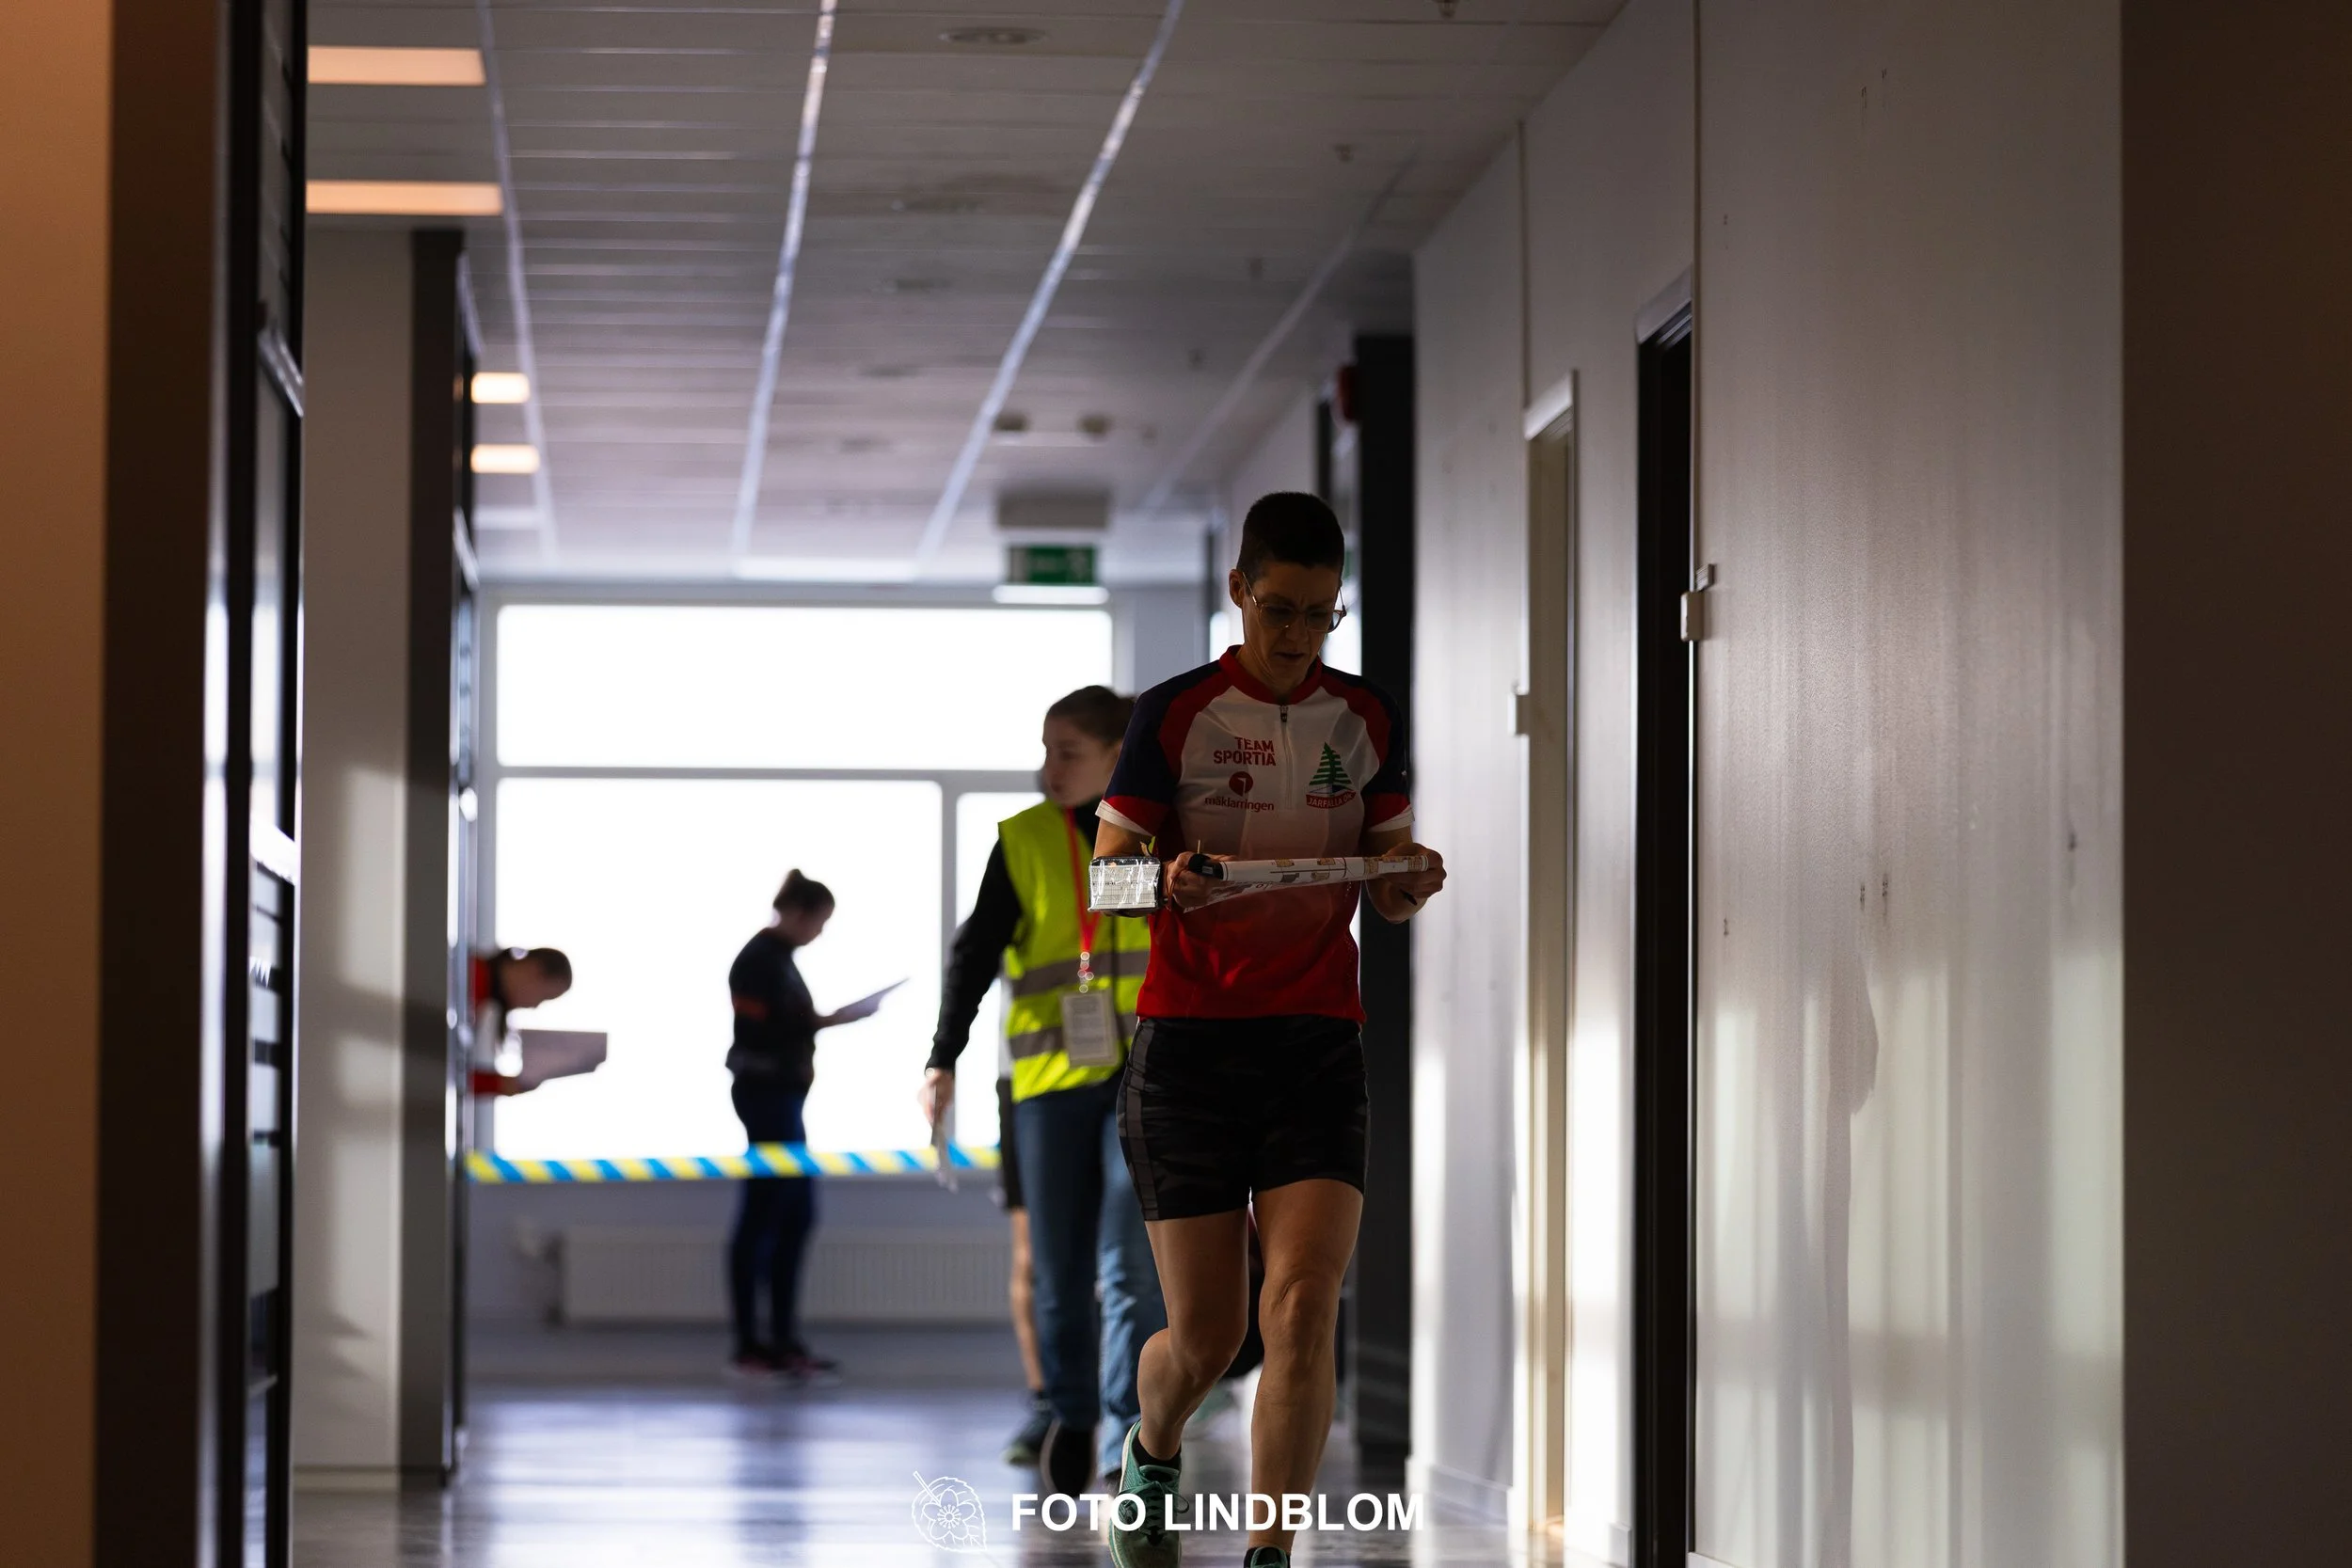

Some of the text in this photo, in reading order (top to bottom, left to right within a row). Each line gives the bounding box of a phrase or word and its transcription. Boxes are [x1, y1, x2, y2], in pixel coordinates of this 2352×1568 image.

[1234, 736, 1274, 752] TEAM
[1214, 750, 1277, 767] SPORTIA
[1204, 796, 1275, 813] mäklarringen
